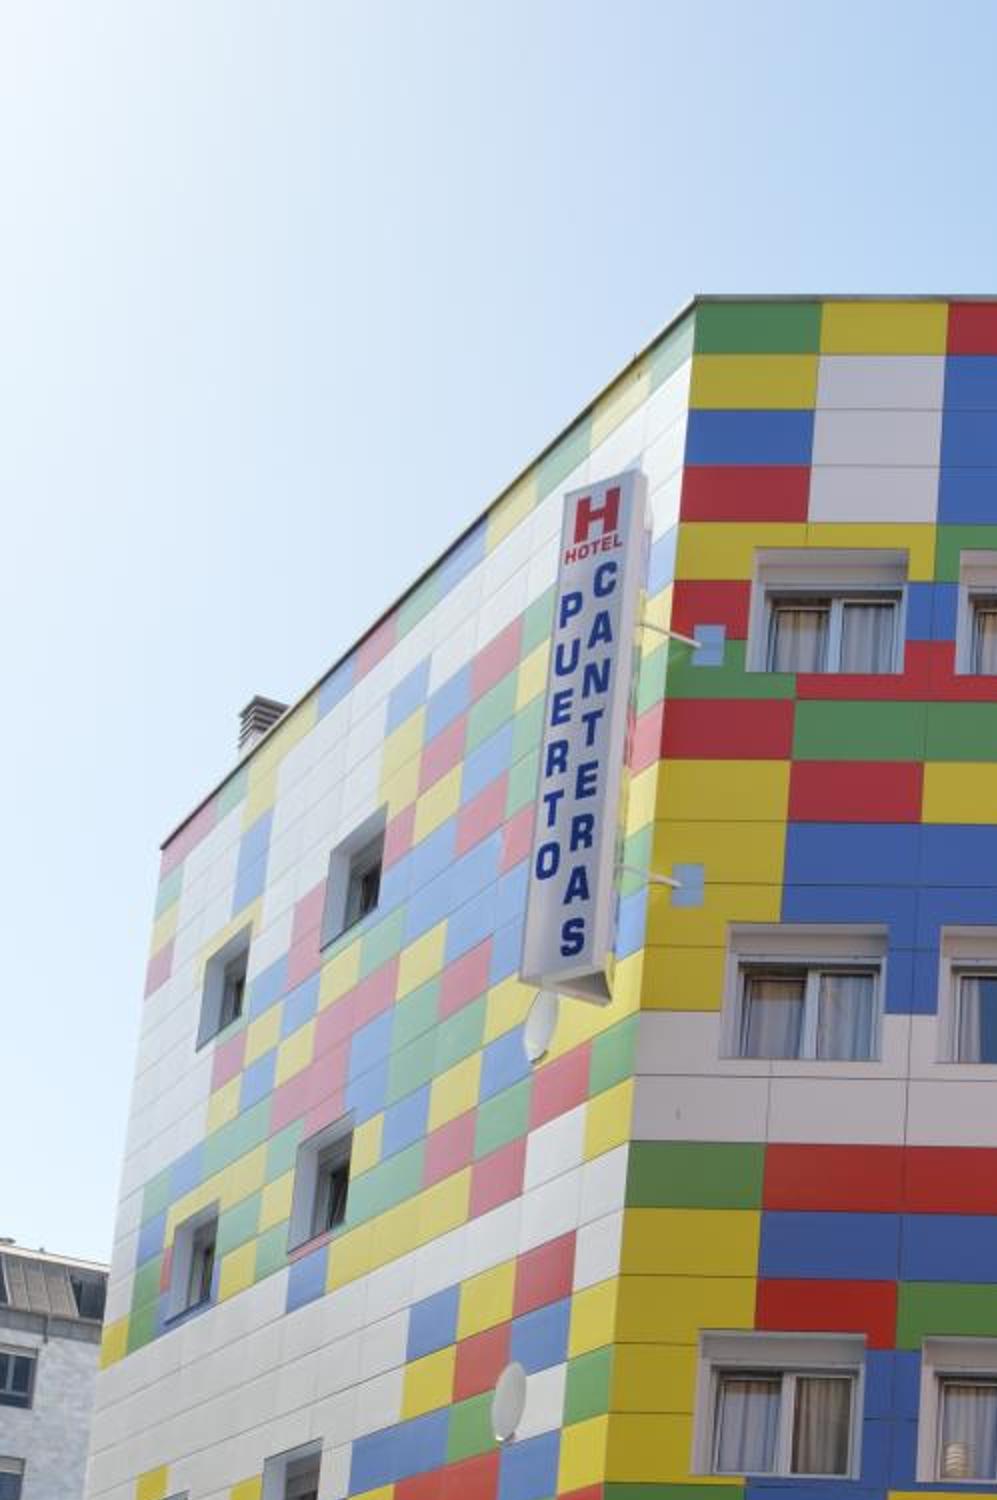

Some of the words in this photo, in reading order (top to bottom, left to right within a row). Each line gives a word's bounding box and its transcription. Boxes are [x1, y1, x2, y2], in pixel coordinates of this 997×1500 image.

[564, 533, 623, 566] HOTEL
[574, 486, 621, 545] H
[536, 590, 583, 881] PUERTO
[560, 560, 617, 958] CANTERAS
